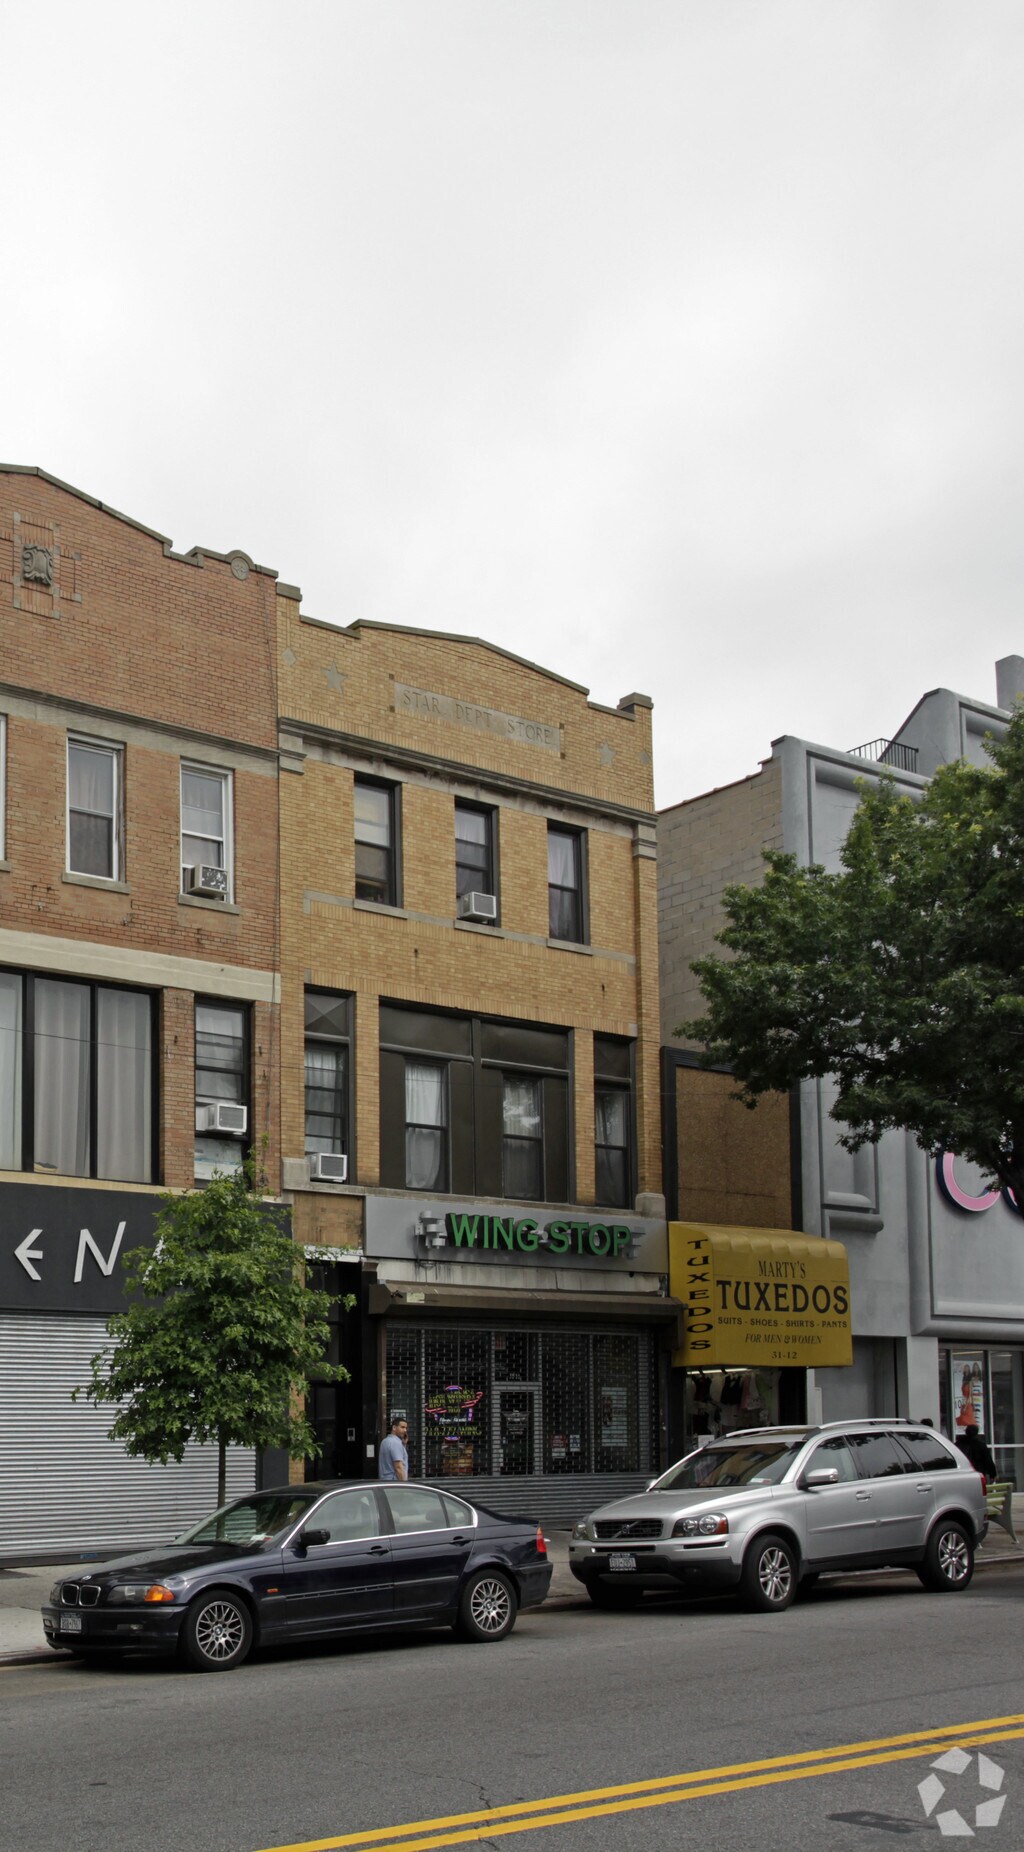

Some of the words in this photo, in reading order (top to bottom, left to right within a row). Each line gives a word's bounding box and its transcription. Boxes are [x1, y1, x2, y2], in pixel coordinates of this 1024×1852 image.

[403, 688, 441, 714] STAR
[455, 703, 493, 729] DEPT
[507, 718, 553, 745] STORE
[758, 1260, 806, 1279] MARTY'S
[687, 1238, 713, 1350] TUXEDOS
[716, 1280, 849, 1315] TUXEDOS
[717, 1316, 743, 1325] SUITS
[750, 1318, 778, 1327] SHOES
[785, 1319, 815, 1328] SHIRTS
[821, 1320, 848, 1328] PANTS
[745, 1333, 761, 1343] FOR
[764, 1334, 782, 1344] MEN
[792, 1335, 823, 1345] WOMEN
[771, 1351, 798, 1360] 31-12
